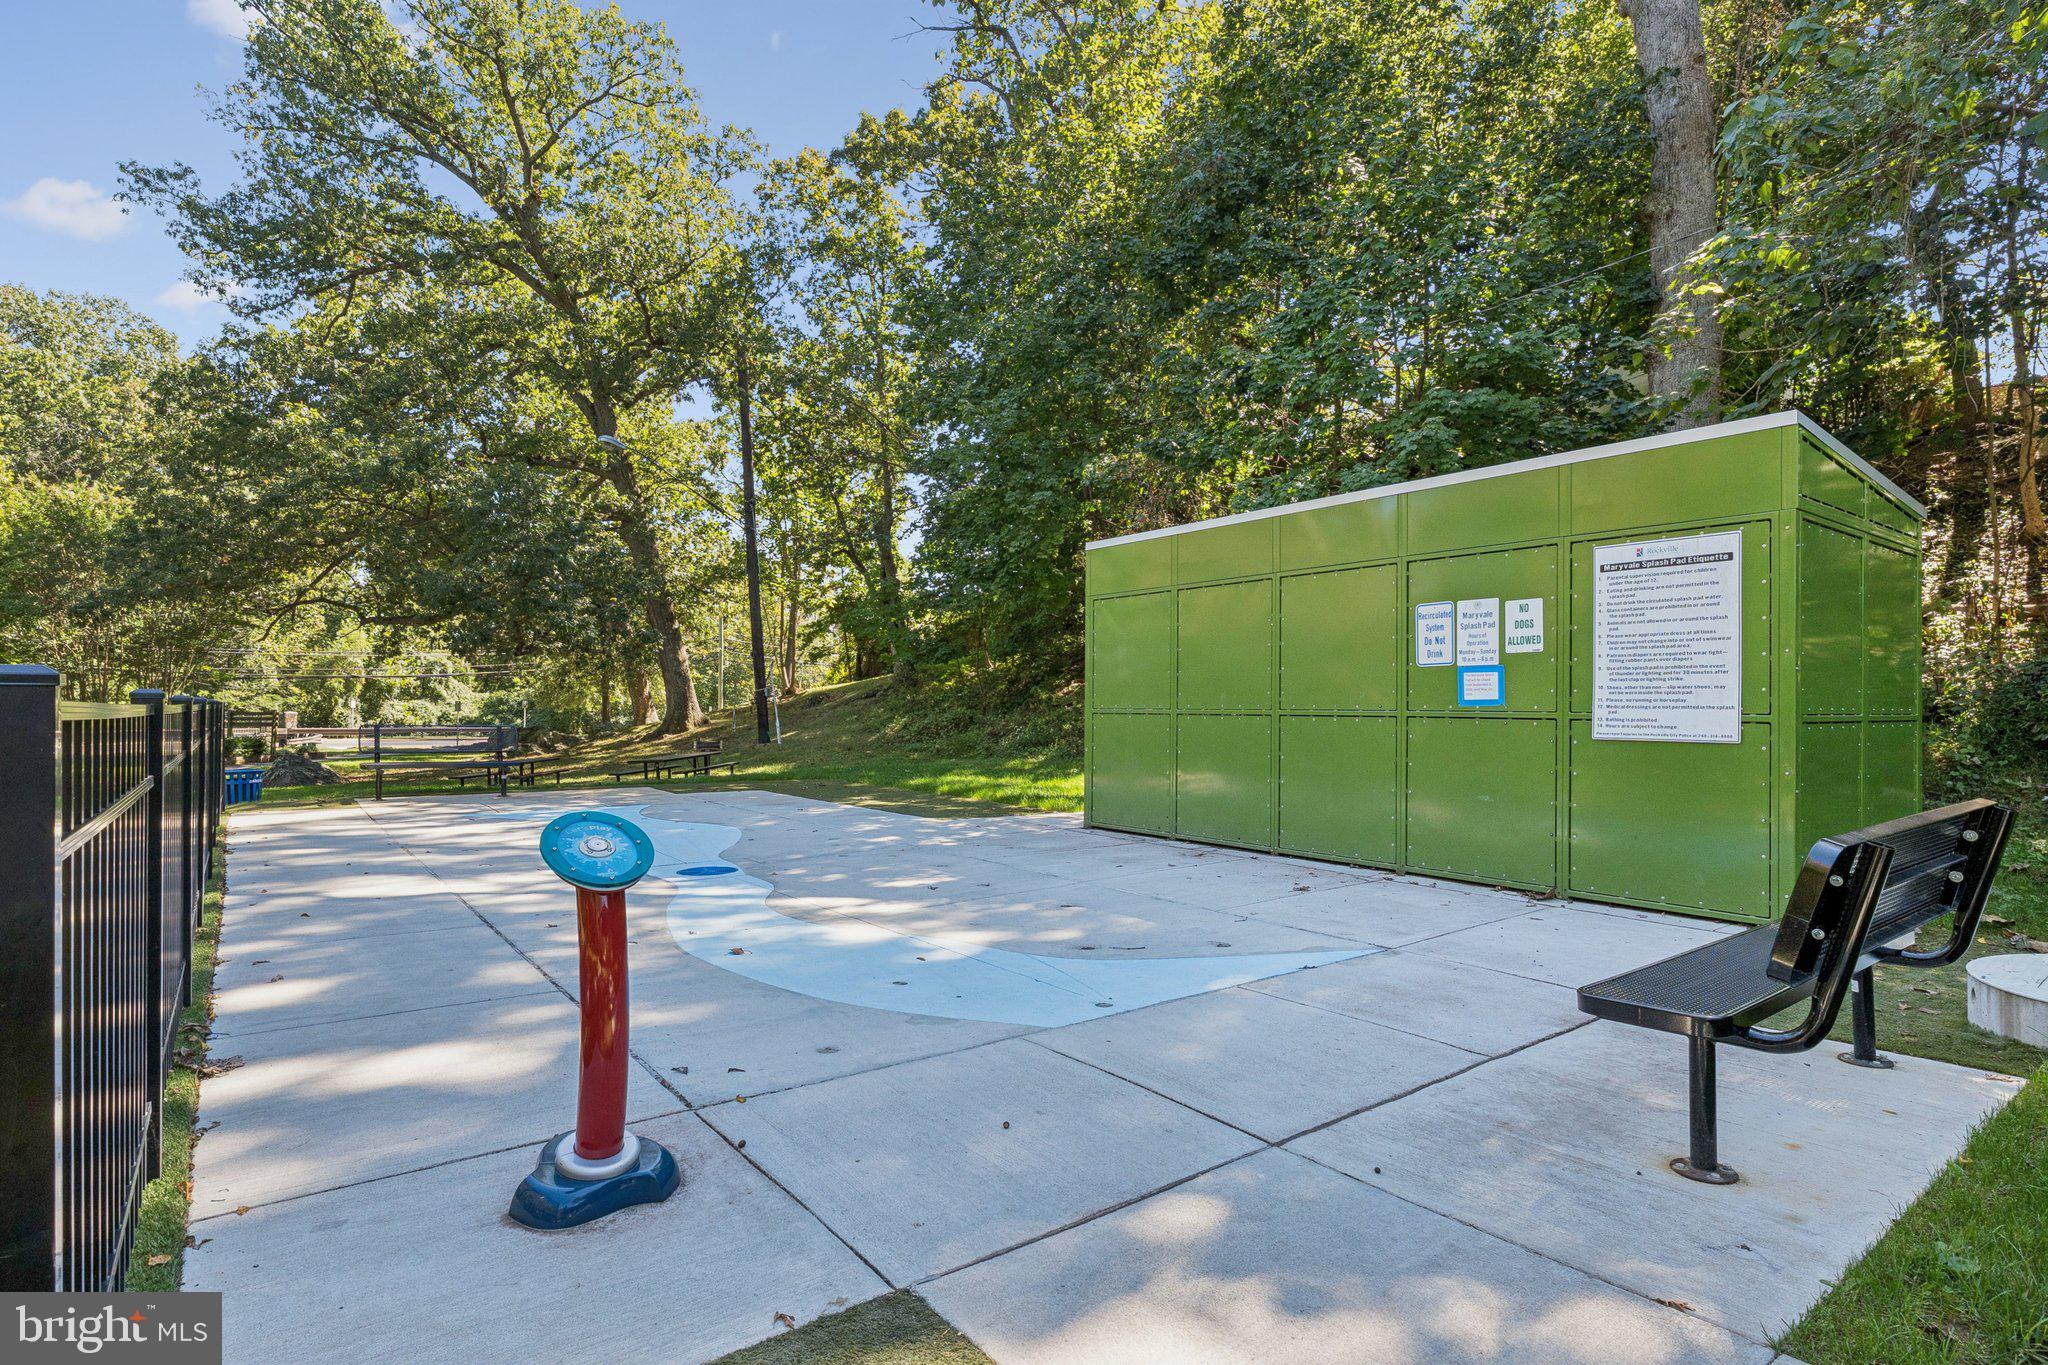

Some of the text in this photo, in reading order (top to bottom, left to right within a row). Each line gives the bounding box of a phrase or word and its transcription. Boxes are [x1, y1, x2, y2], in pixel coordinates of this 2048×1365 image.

[1646, 544, 1679, 555] Rockville
[1604, 552, 1729, 573] Maryvale Splash Pad Etiquette
[1660, 569, 1684, 577] required
[1675, 581, 1703, 589] permitted
[1519, 603, 1529, 613] NO
[1659, 603, 1686, 611] prohibited
[1417, 610, 1453, 620] Recirculated
[1462, 611, 1494, 620] Maryvale
[1426, 623, 1444, 633] System
[1460, 621, 1496, 631] Splash Pad
[1515, 619, 1534, 629] DOGS
[1424, 636, 1446, 645] Do Not
[1508, 635, 1541, 646] ALLOWED
[1427, 649, 1443, 658] Drink
